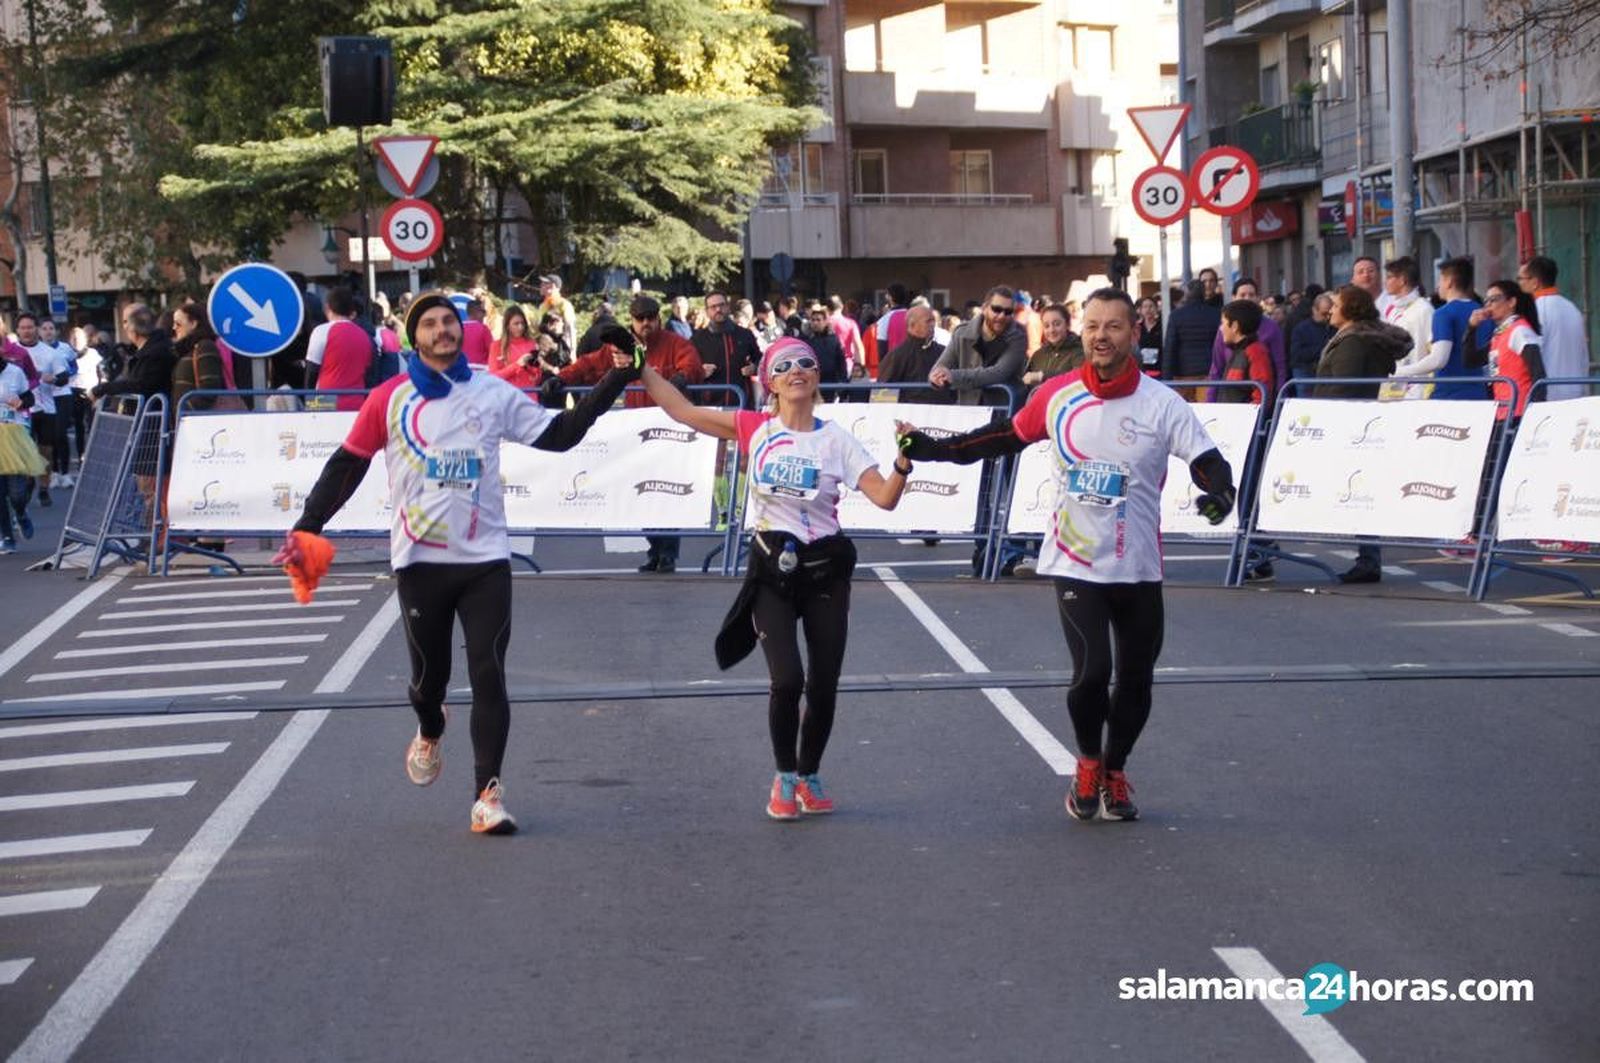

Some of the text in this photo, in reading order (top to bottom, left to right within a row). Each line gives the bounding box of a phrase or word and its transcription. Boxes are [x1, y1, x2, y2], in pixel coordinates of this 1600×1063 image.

[1145, 186, 1179, 206] 30
[395, 221, 429, 240] 30
[436, 458, 468, 478] 3721
[769, 463, 804, 484] 4218
[1076, 471, 1112, 491] 4217
